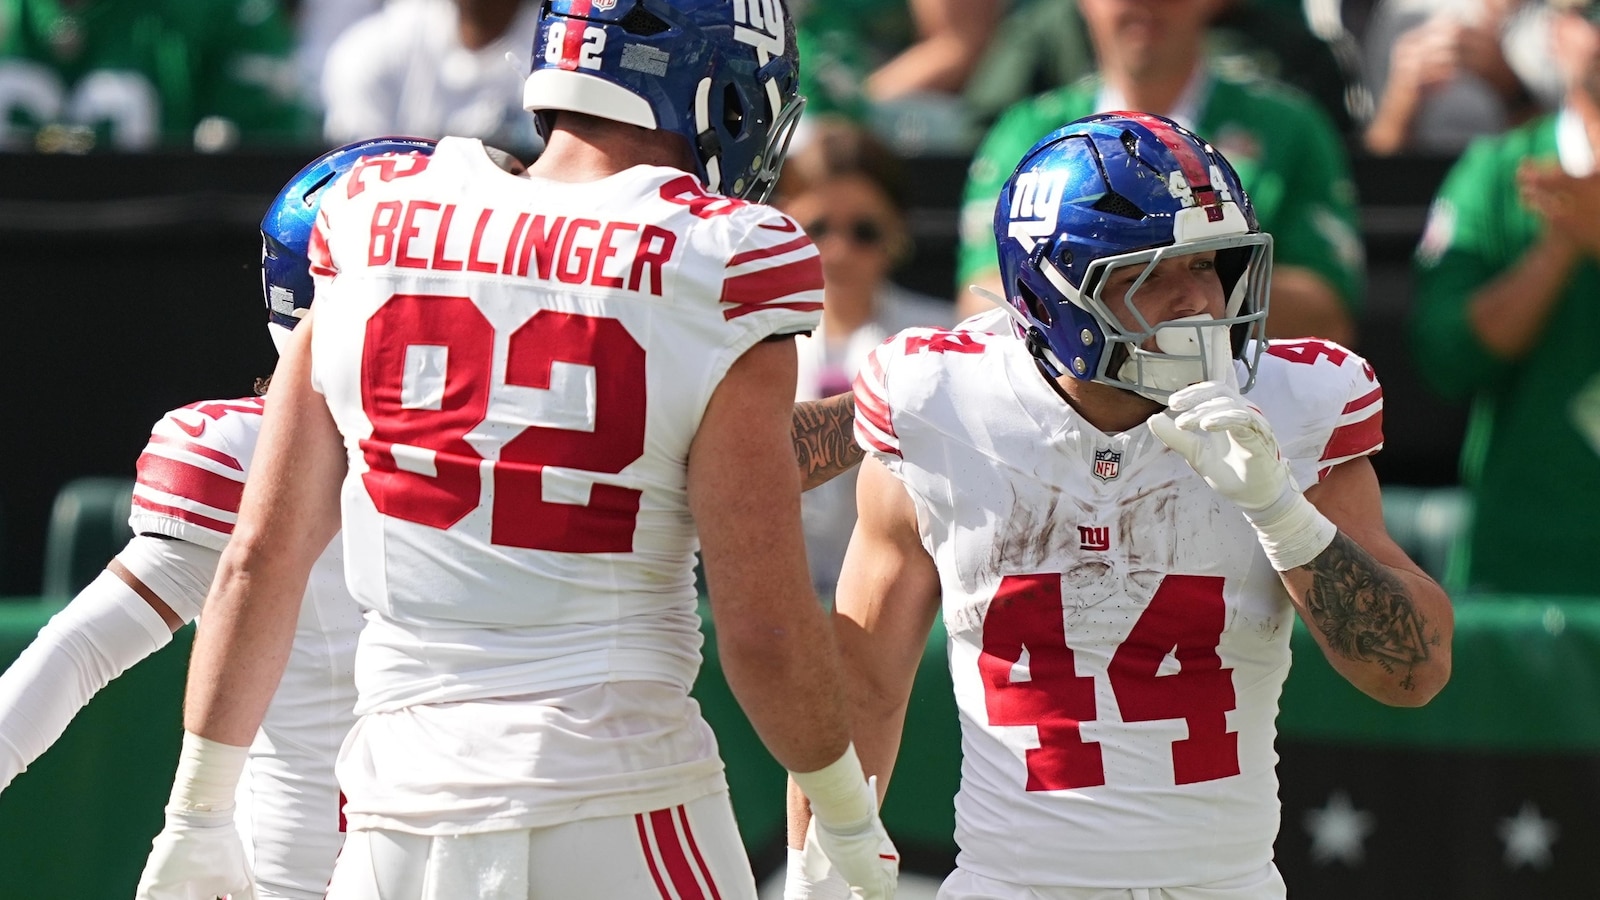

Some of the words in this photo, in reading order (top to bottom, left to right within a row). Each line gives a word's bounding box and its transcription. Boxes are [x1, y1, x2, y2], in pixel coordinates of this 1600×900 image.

[544, 22, 607, 70] 82
[1008, 169, 1070, 238] ny
[1168, 164, 1234, 208] 44
[367, 200, 677, 297] BELLINGER
[359, 293, 648, 553] 82
[1095, 461, 1118, 477] NFL
[1077, 525, 1109, 551] ny
[978, 573, 1241, 792] 44
